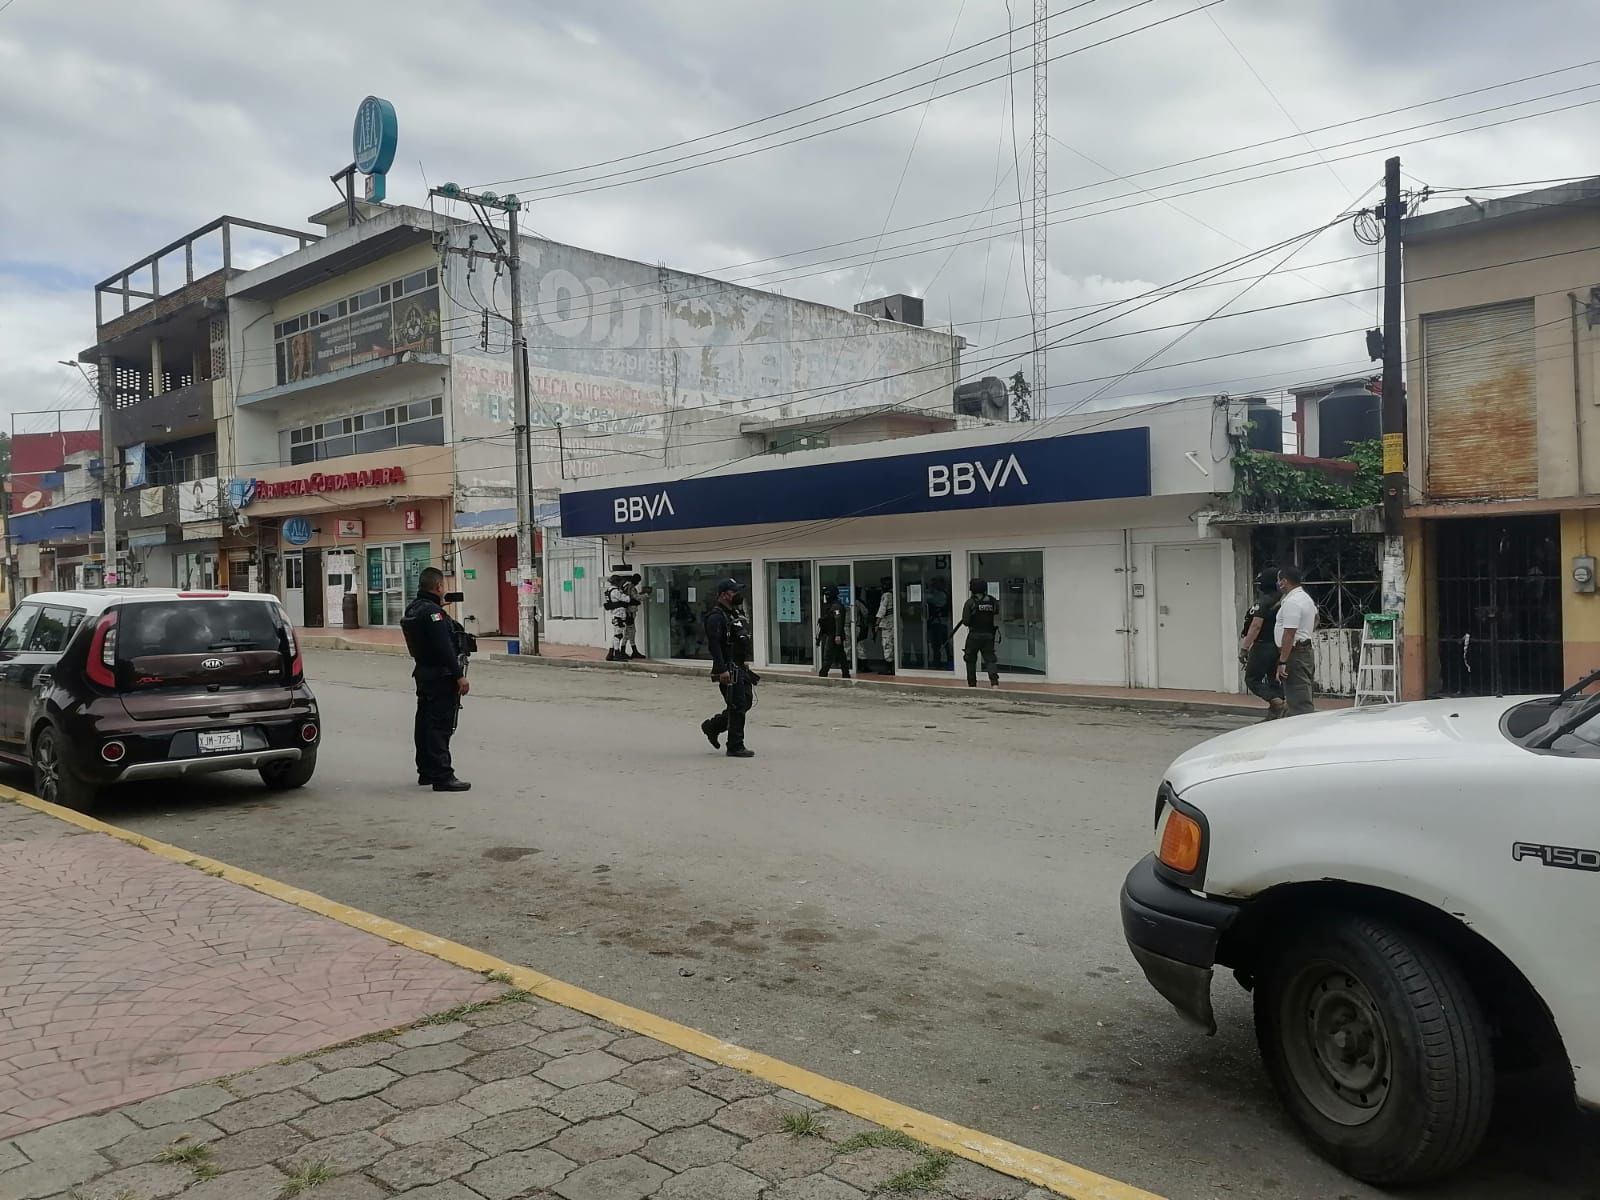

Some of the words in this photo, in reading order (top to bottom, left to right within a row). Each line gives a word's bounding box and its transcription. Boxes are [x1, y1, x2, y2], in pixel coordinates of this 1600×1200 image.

[928, 453, 1028, 497] BBVA
[614, 490, 675, 523] BBVA
[203, 659, 222, 669] KIA
[1512, 841, 1600, 872] F-150
